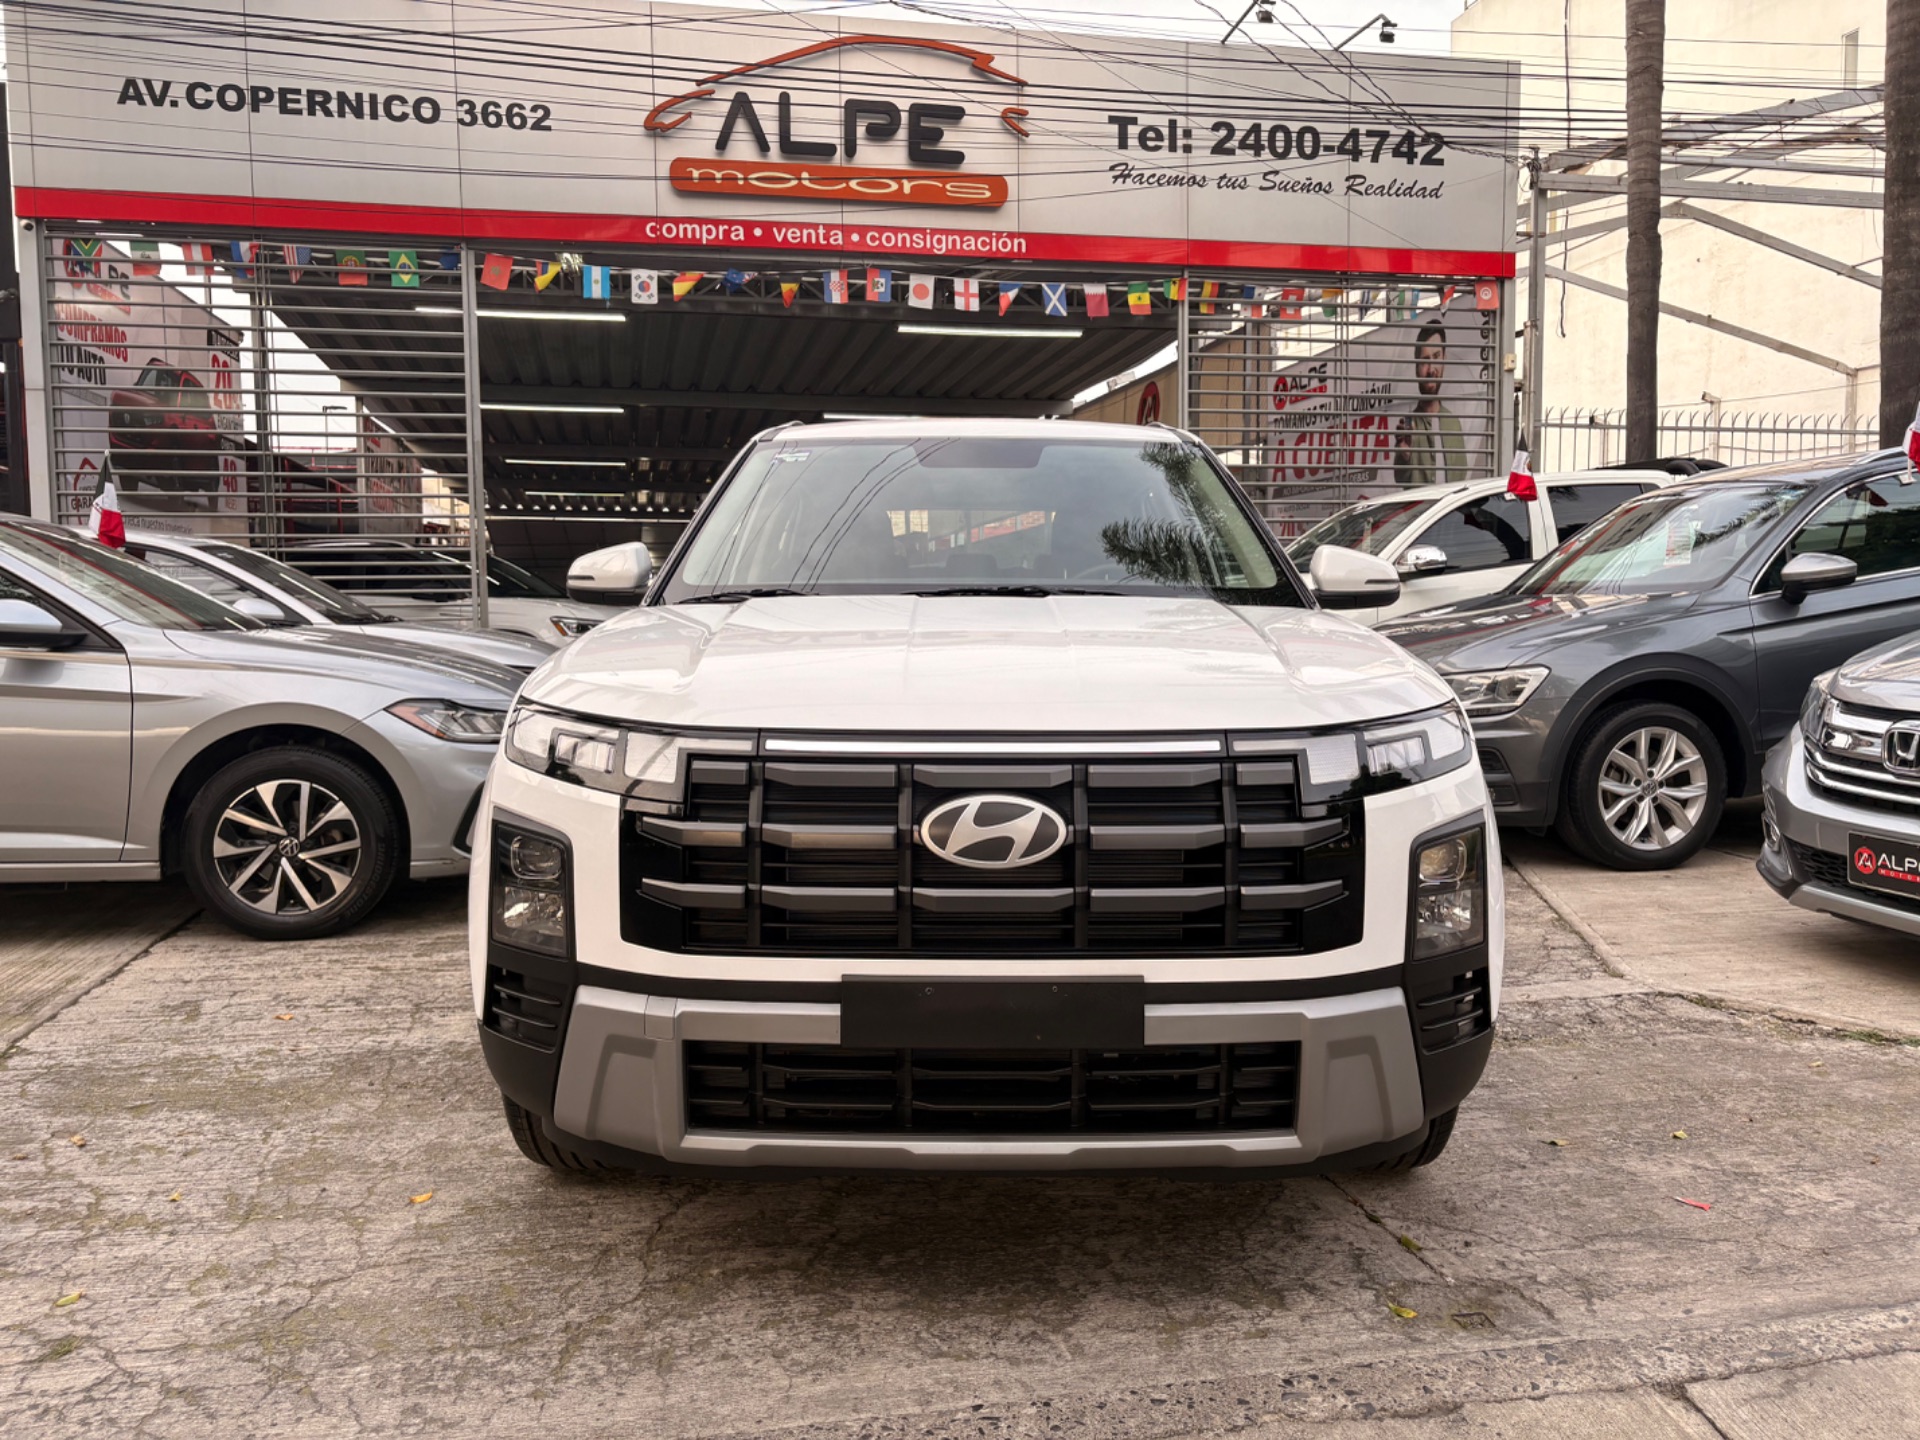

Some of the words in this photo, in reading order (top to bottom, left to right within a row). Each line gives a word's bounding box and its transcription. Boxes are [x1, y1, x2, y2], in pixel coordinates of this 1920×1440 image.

[456, 99, 552, 132] 3662
[715, 91, 966, 164] ALPE
[1108, 115, 1193, 154] Tel:
[1210, 121, 1445, 166] 2400-4742
[686, 166, 992, 199] motors
[1109, 162, 1208, 189] Hacemos
[1216, 172, 1249, 190] tus
[1258, 169, 1334, 195] Sueños
[1344, 174, 1445, 199] Realidad
[645, 221, 745, 245] compra
[772, 224, 843, 246] venta
[865, 229, 1027, 255] consignación
[77, 343, 107, 386] AUTO
[1292, 415, 1390, 479] CUENTA
[1878, 853, 1920, 872] ALP
